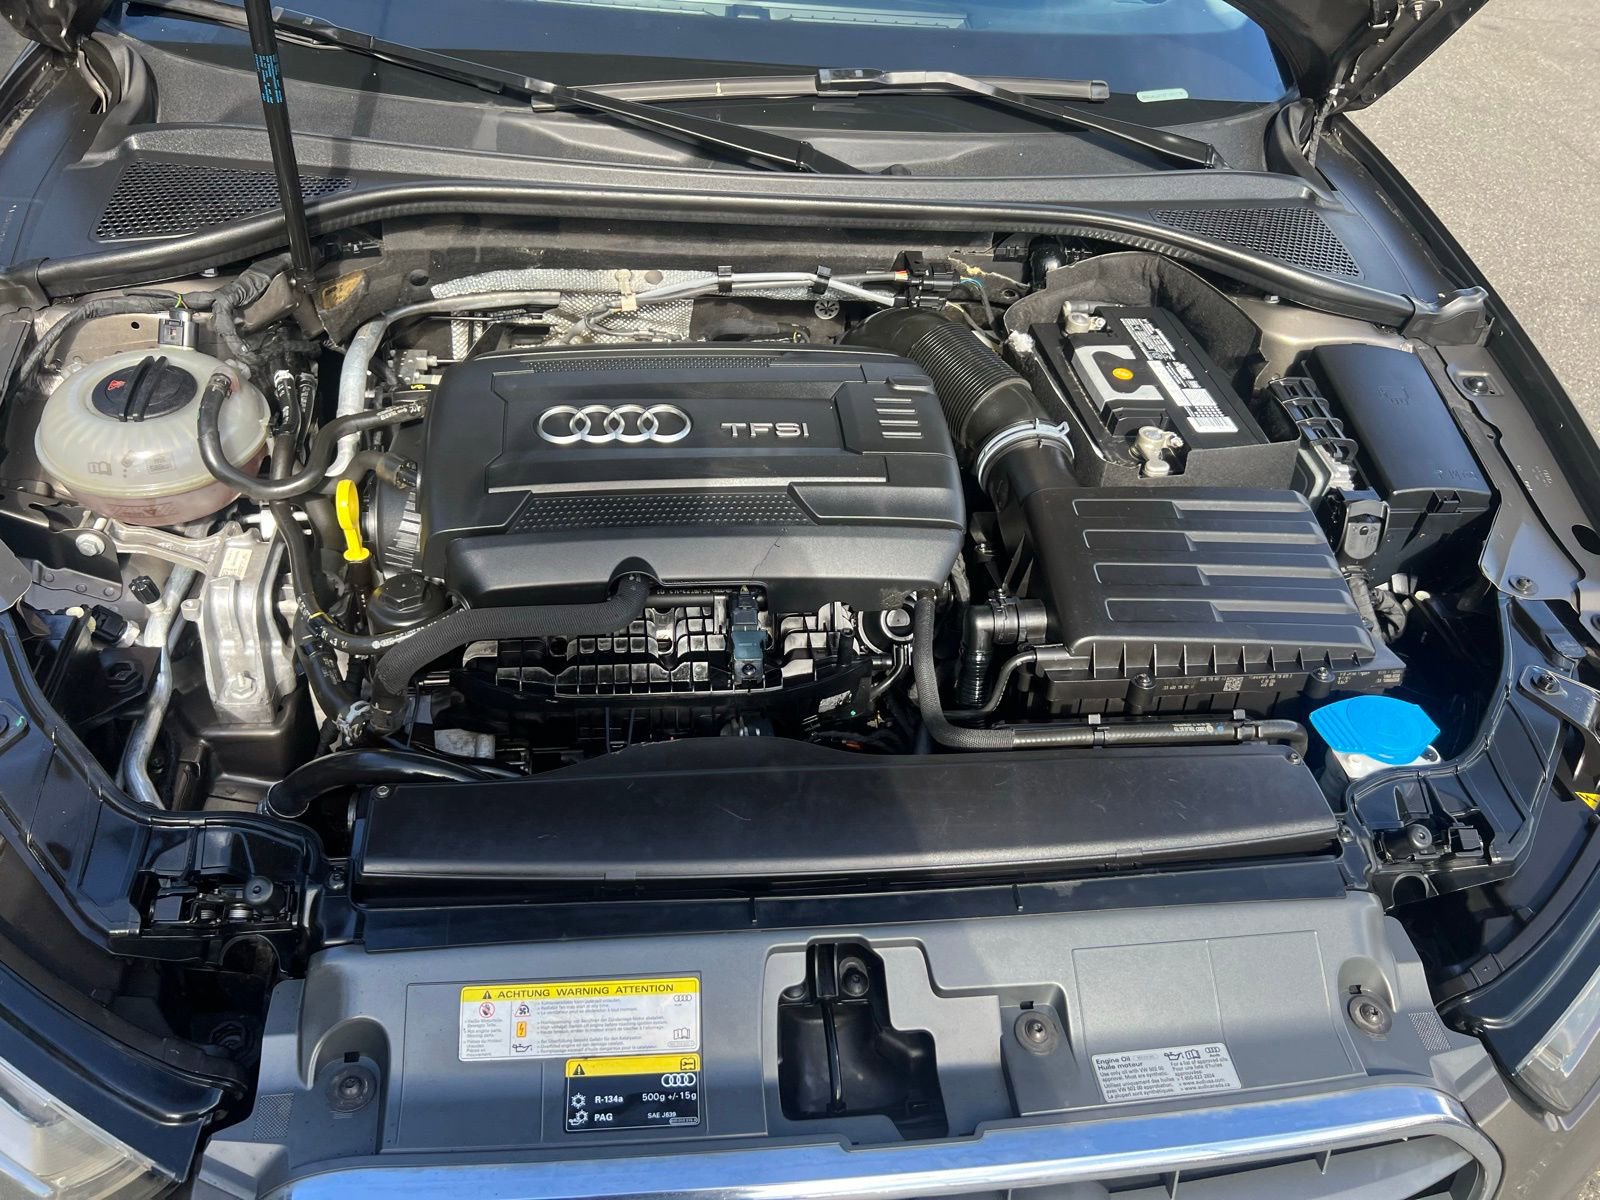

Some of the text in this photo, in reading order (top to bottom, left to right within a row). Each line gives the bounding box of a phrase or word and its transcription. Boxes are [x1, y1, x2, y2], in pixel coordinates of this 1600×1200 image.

[720, 422, 810, 438] TFSI
[497, 983, 674, 999] ACHTUNG WARNING ATTENTION
[1095, 1057, 1120, 1065] Engine
[595, 1095, 623, 1104] R-134a
[642, 1092, 665, 1102] 500g
[594, 1113, 613, 1121] PAG
